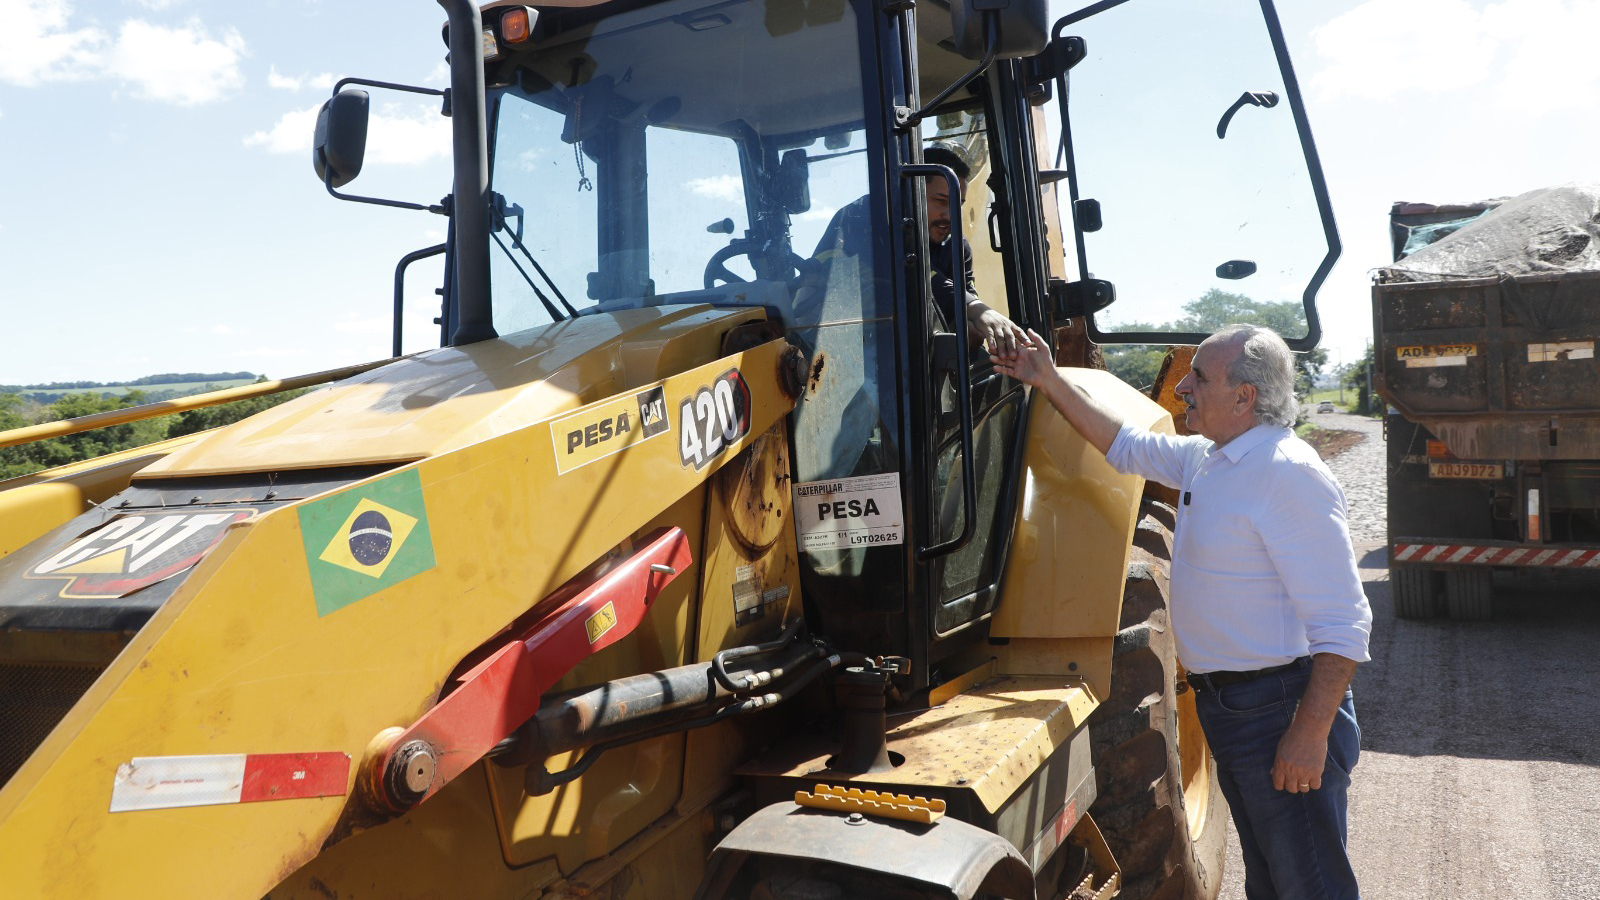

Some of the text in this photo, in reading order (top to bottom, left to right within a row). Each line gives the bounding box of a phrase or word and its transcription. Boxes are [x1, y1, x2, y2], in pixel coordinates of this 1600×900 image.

[567, 399, 663, 455] PESA CAT
[681, 379, 738, 465] 420
[1437, 464, 1496, 478] ADJ9D72
[797, 483, 843, 496] CATERPILLAR
[818, 498, 880, 521] PESA
[34, 512, 236, 574] CAT
[850, 533, 898, 545] L9T02625
[292, 770, 306, 780] 3M
